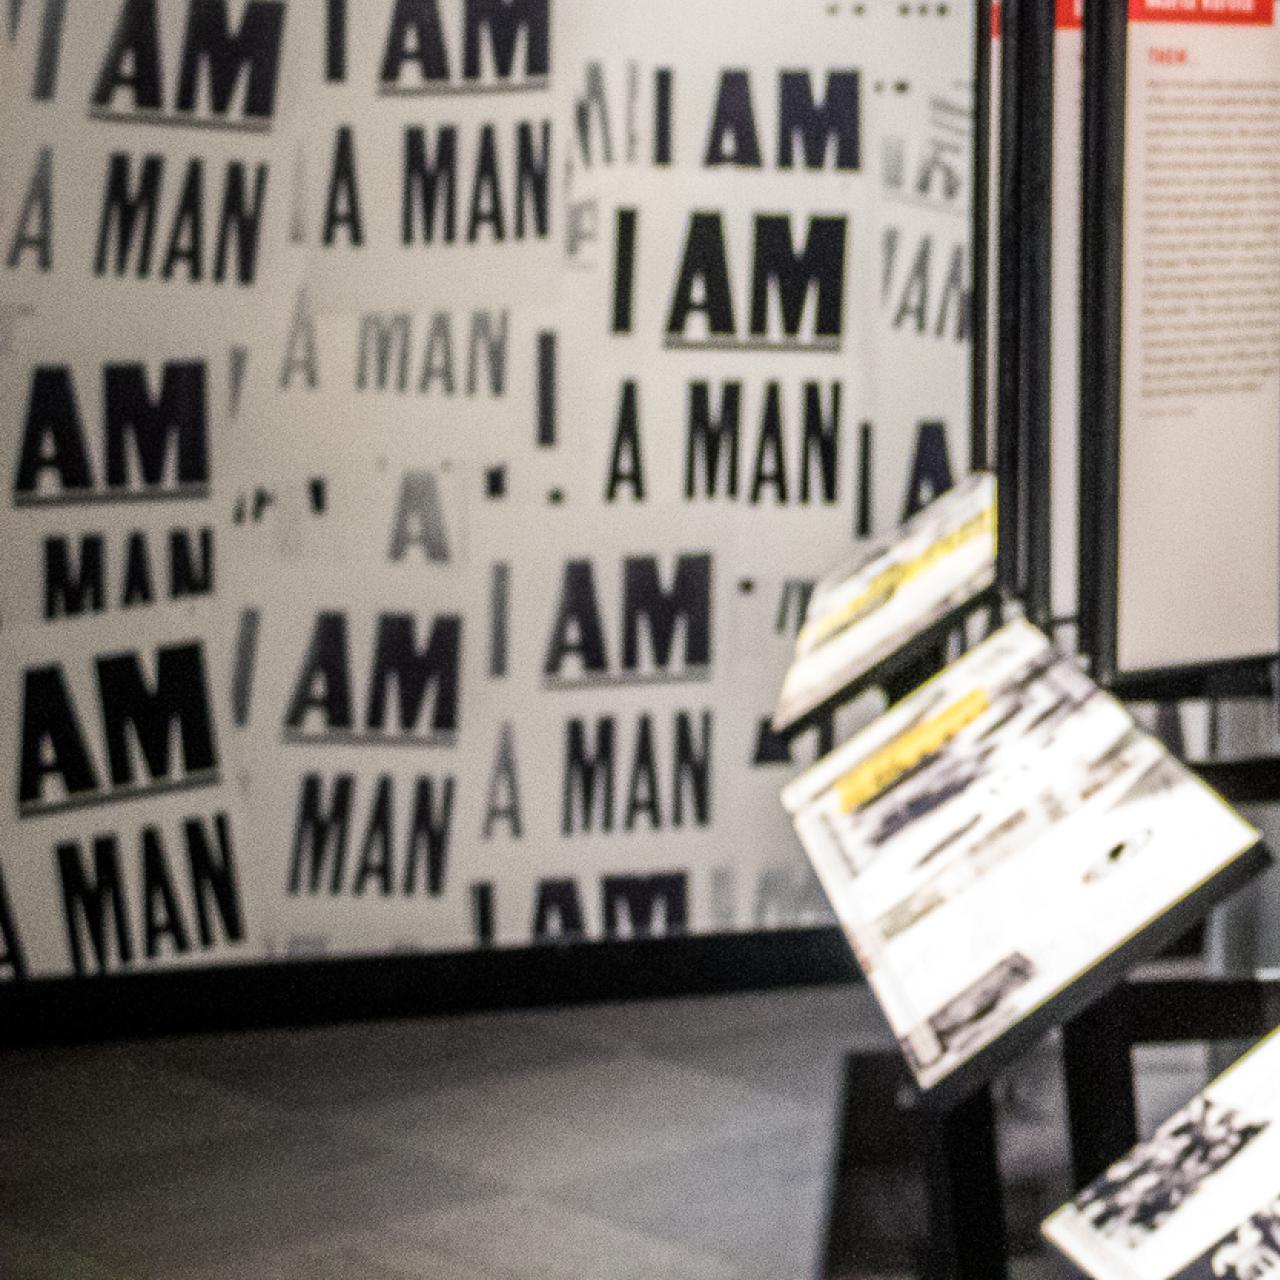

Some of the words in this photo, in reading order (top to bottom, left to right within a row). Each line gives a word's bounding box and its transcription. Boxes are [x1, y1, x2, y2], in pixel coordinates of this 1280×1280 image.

[655, 69, 673, 166] I
[703, 69, 861, 170] AM
[95, 152, 270, 286] MAN
[322, 126, 363, 247] A
[402, 121, 551, 246] MAN
[611, 208, 636, 334] I
[666, 211, 848, 337] AM
[14, 361, 209, 490] AM
[606, 379, 644, 503] A
[684, 379, 841, 505] MAN
[286, 611, 461, 732] AM
[544, 554, 712, 674] AM
[19, 640, 216, 802] AM
[561, 712, 710, 838] MAN
[289, 773, 457, 897] MAN
